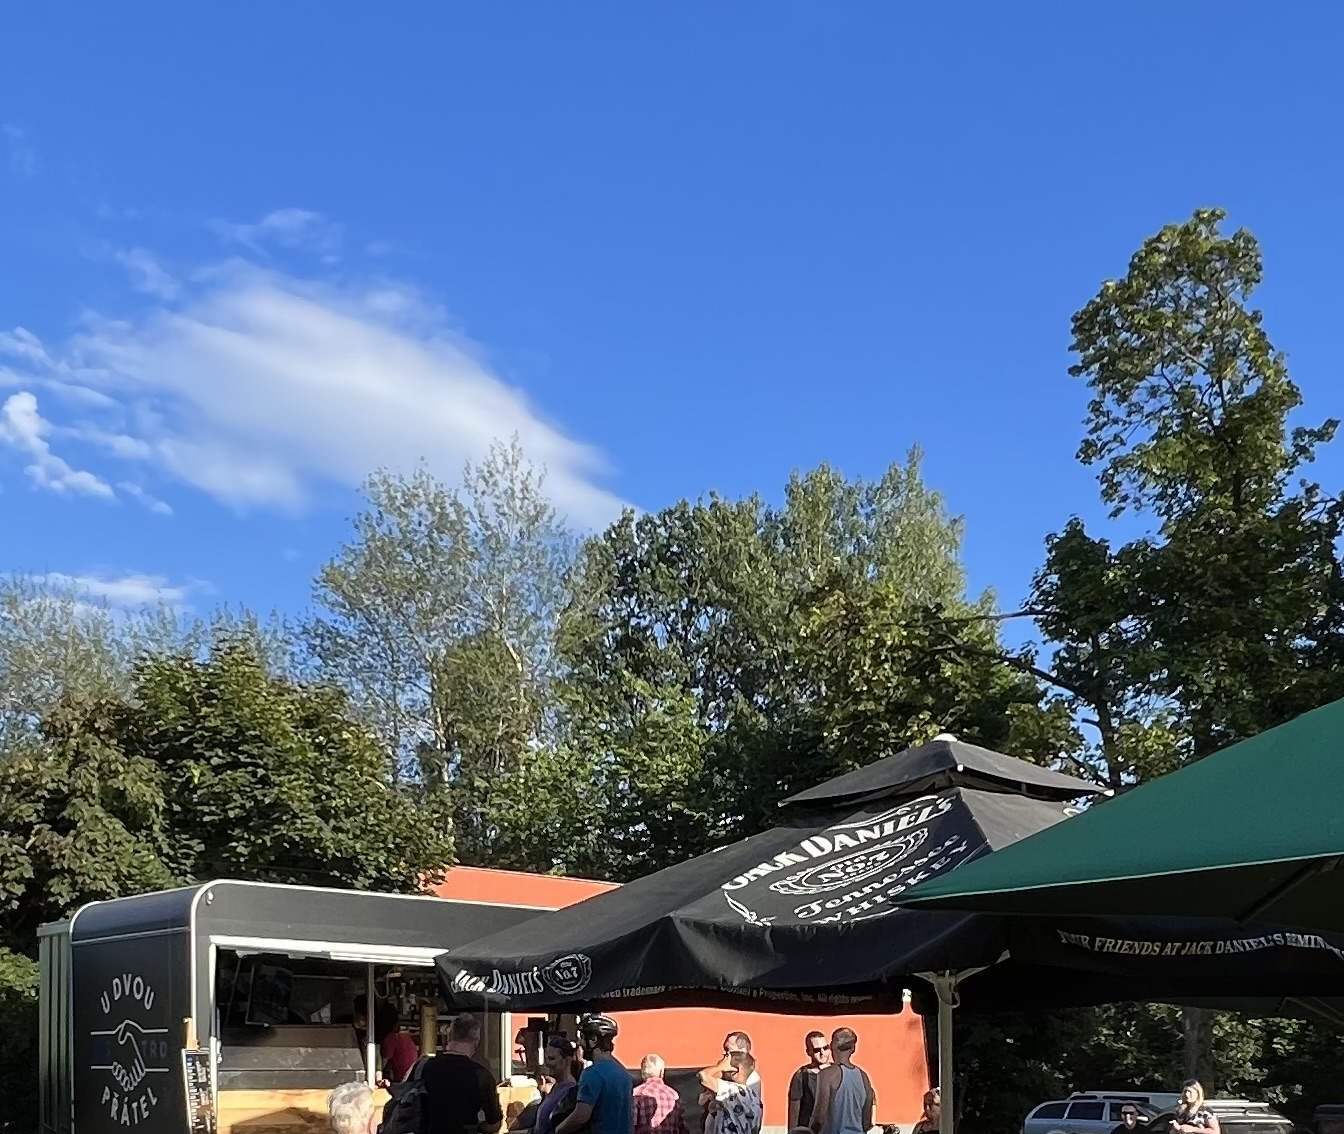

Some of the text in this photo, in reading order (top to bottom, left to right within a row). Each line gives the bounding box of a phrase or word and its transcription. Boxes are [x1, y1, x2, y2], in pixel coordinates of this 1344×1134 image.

[1094, 937, 1162, 955] FRIENDS
[1161, 942, 1183, 956] AT
[1181, 941, 1215, 956] JACK
[1215, 933, 1285, 954] DANIEL'S
[101, 973, 155, 1014] U DVOU
[100, 1085, 158, 1126] PŘÁTEL
